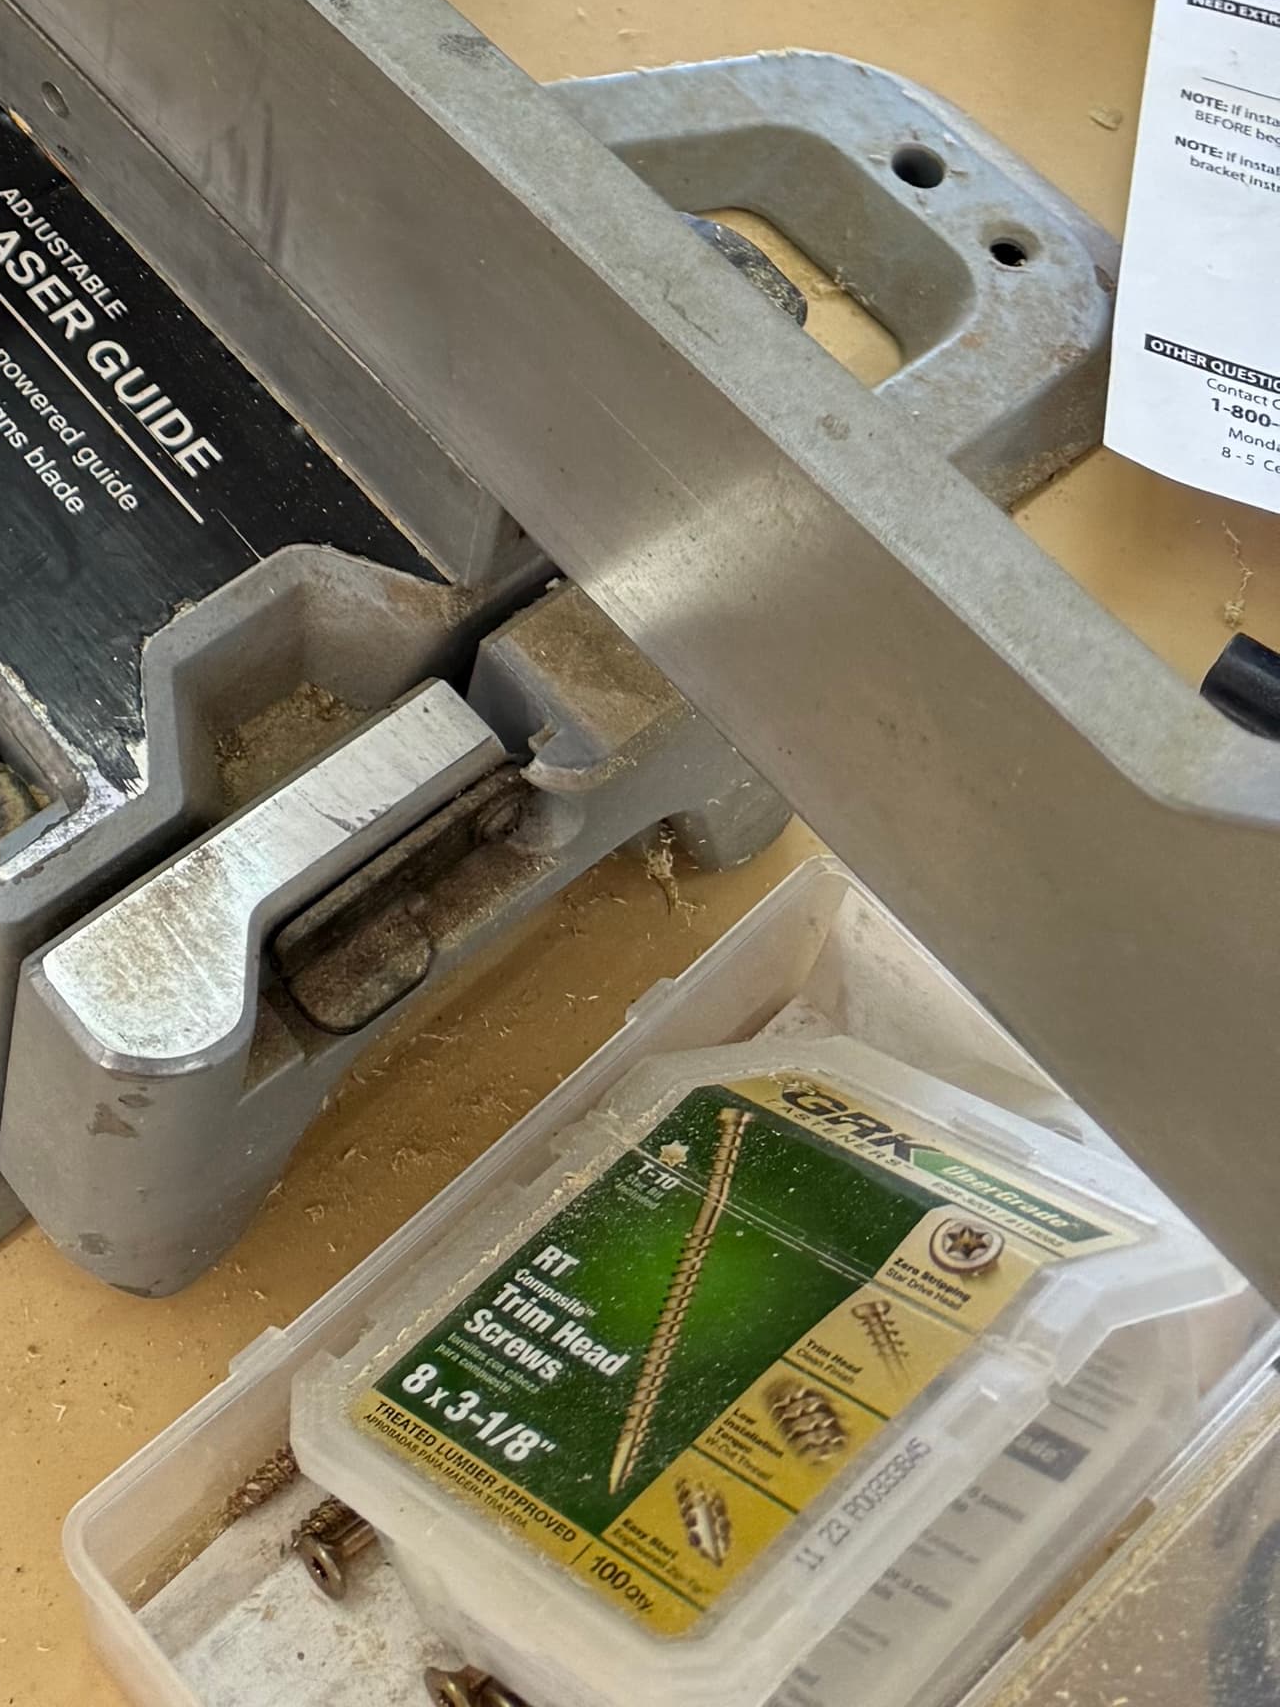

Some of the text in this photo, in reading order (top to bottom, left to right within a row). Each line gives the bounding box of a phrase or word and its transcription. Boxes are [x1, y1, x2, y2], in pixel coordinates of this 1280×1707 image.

[1180, 89, 1242, 116] NOTE: If
[1195, 109, 1252, 136] BEFORE
[1175, 135, 1237, 163] NOTE: If
[1190, 155, 1246, 182] bracket
[1150, 339, 1207, 368] OTHER
[87, 339, 223, 478] GUIDE
[1206, 377, 1268, 407] Contact
[1221, 446, 1255, 466] 8 5
[23, 446, 85, 515] blade
[72, 444, 139, 512] guide
[781, 1085, 920, 1164] GRK
[637, 1159, 680, 1194] T-10
[532, 1244, 580, 1279] RT
[464, 1307, 565, 1382] Screws
[491, 1283, 631, 1377] Trim Head
[401, 1362, 436, 1395] 8
[425, 1385, 443, 1409] x
[374, 1399, 436, 1449] TREATED
[435, 1436, 499, 1489] LUMBER
[495, 1480, 579, 1545] APPROVED
